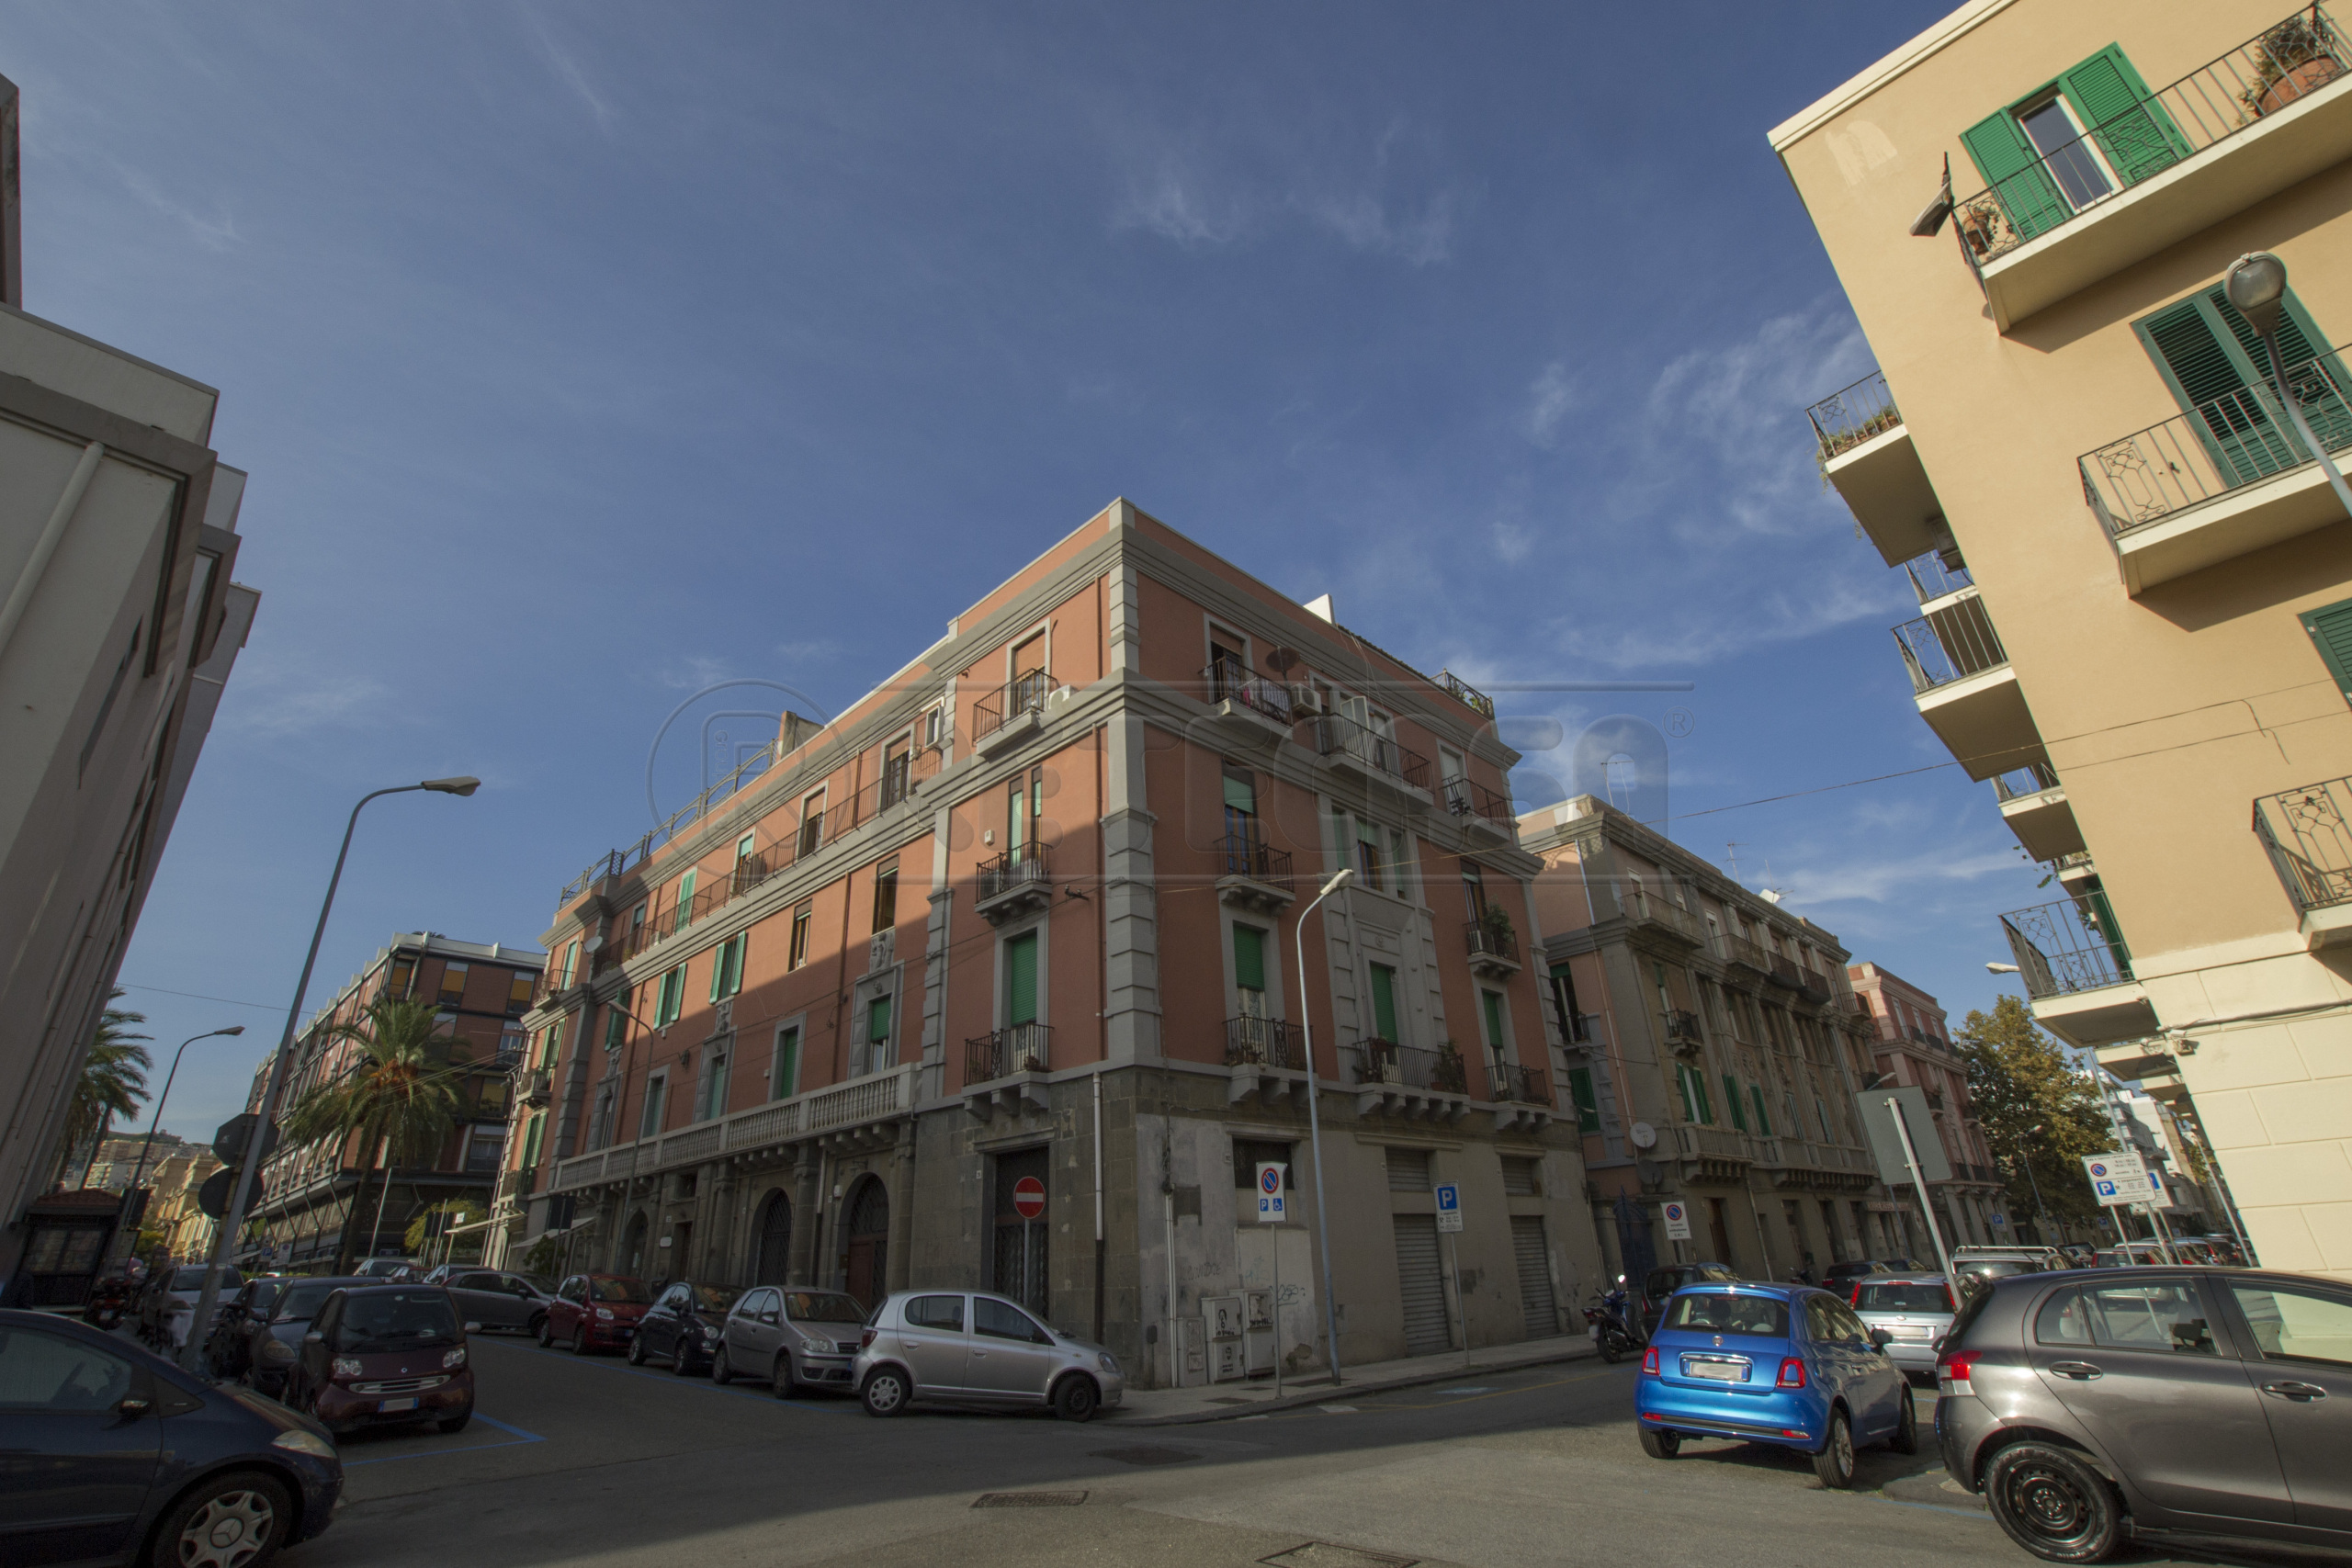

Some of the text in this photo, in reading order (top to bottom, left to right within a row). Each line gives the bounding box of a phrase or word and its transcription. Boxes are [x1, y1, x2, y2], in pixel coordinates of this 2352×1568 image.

[2099, 1182, 2111, 1195] P
[1261, 1200, 1268, 1211] P
[1442, 1190, 1453, 1208] P
